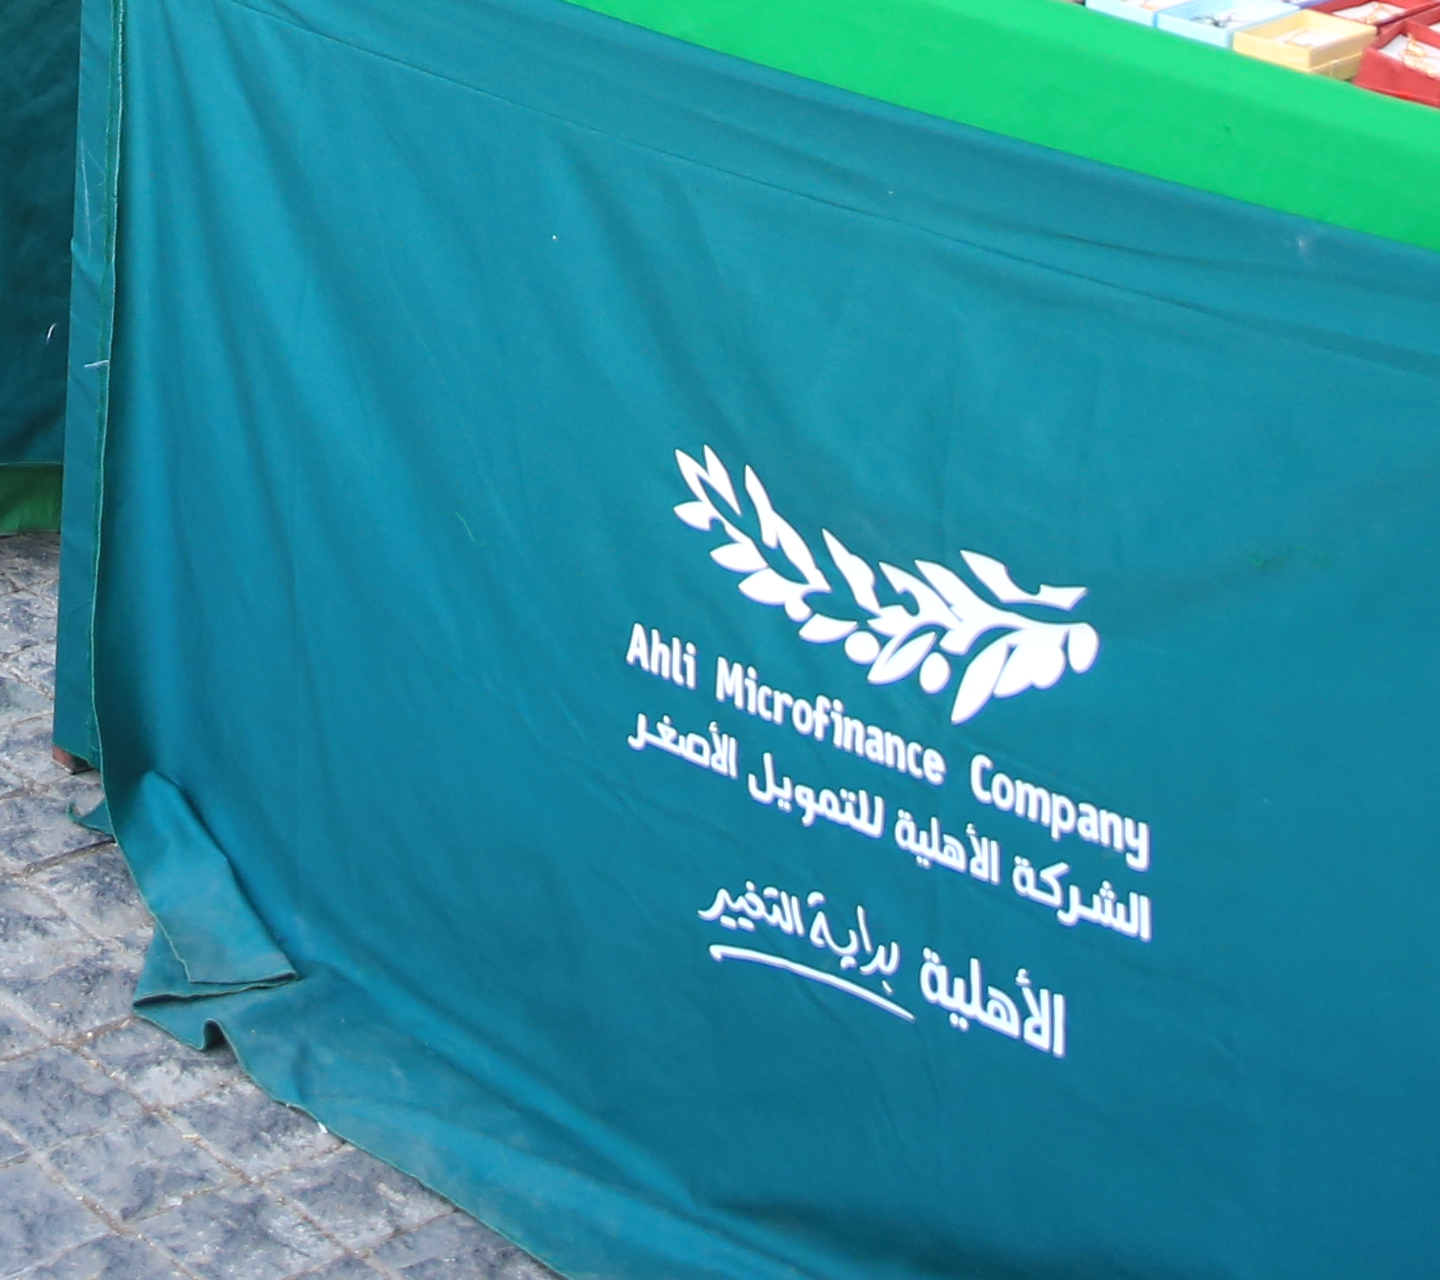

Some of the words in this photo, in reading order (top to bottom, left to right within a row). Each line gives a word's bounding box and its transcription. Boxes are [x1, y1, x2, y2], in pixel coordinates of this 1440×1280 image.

[627, 624, 696, 688] Ahli
[716, 657, 946, 784] Microfinance
[971, 755, 1149, 871] Company
[628, 714, 737, 778] الأصغر
[749, 753, 884, 837] للتمويل
[895, 810, 999, 884] الأهلية
[1013, 856, 1151, 941] الشركة
[921, 948, 1065, 1056] الأهلية
